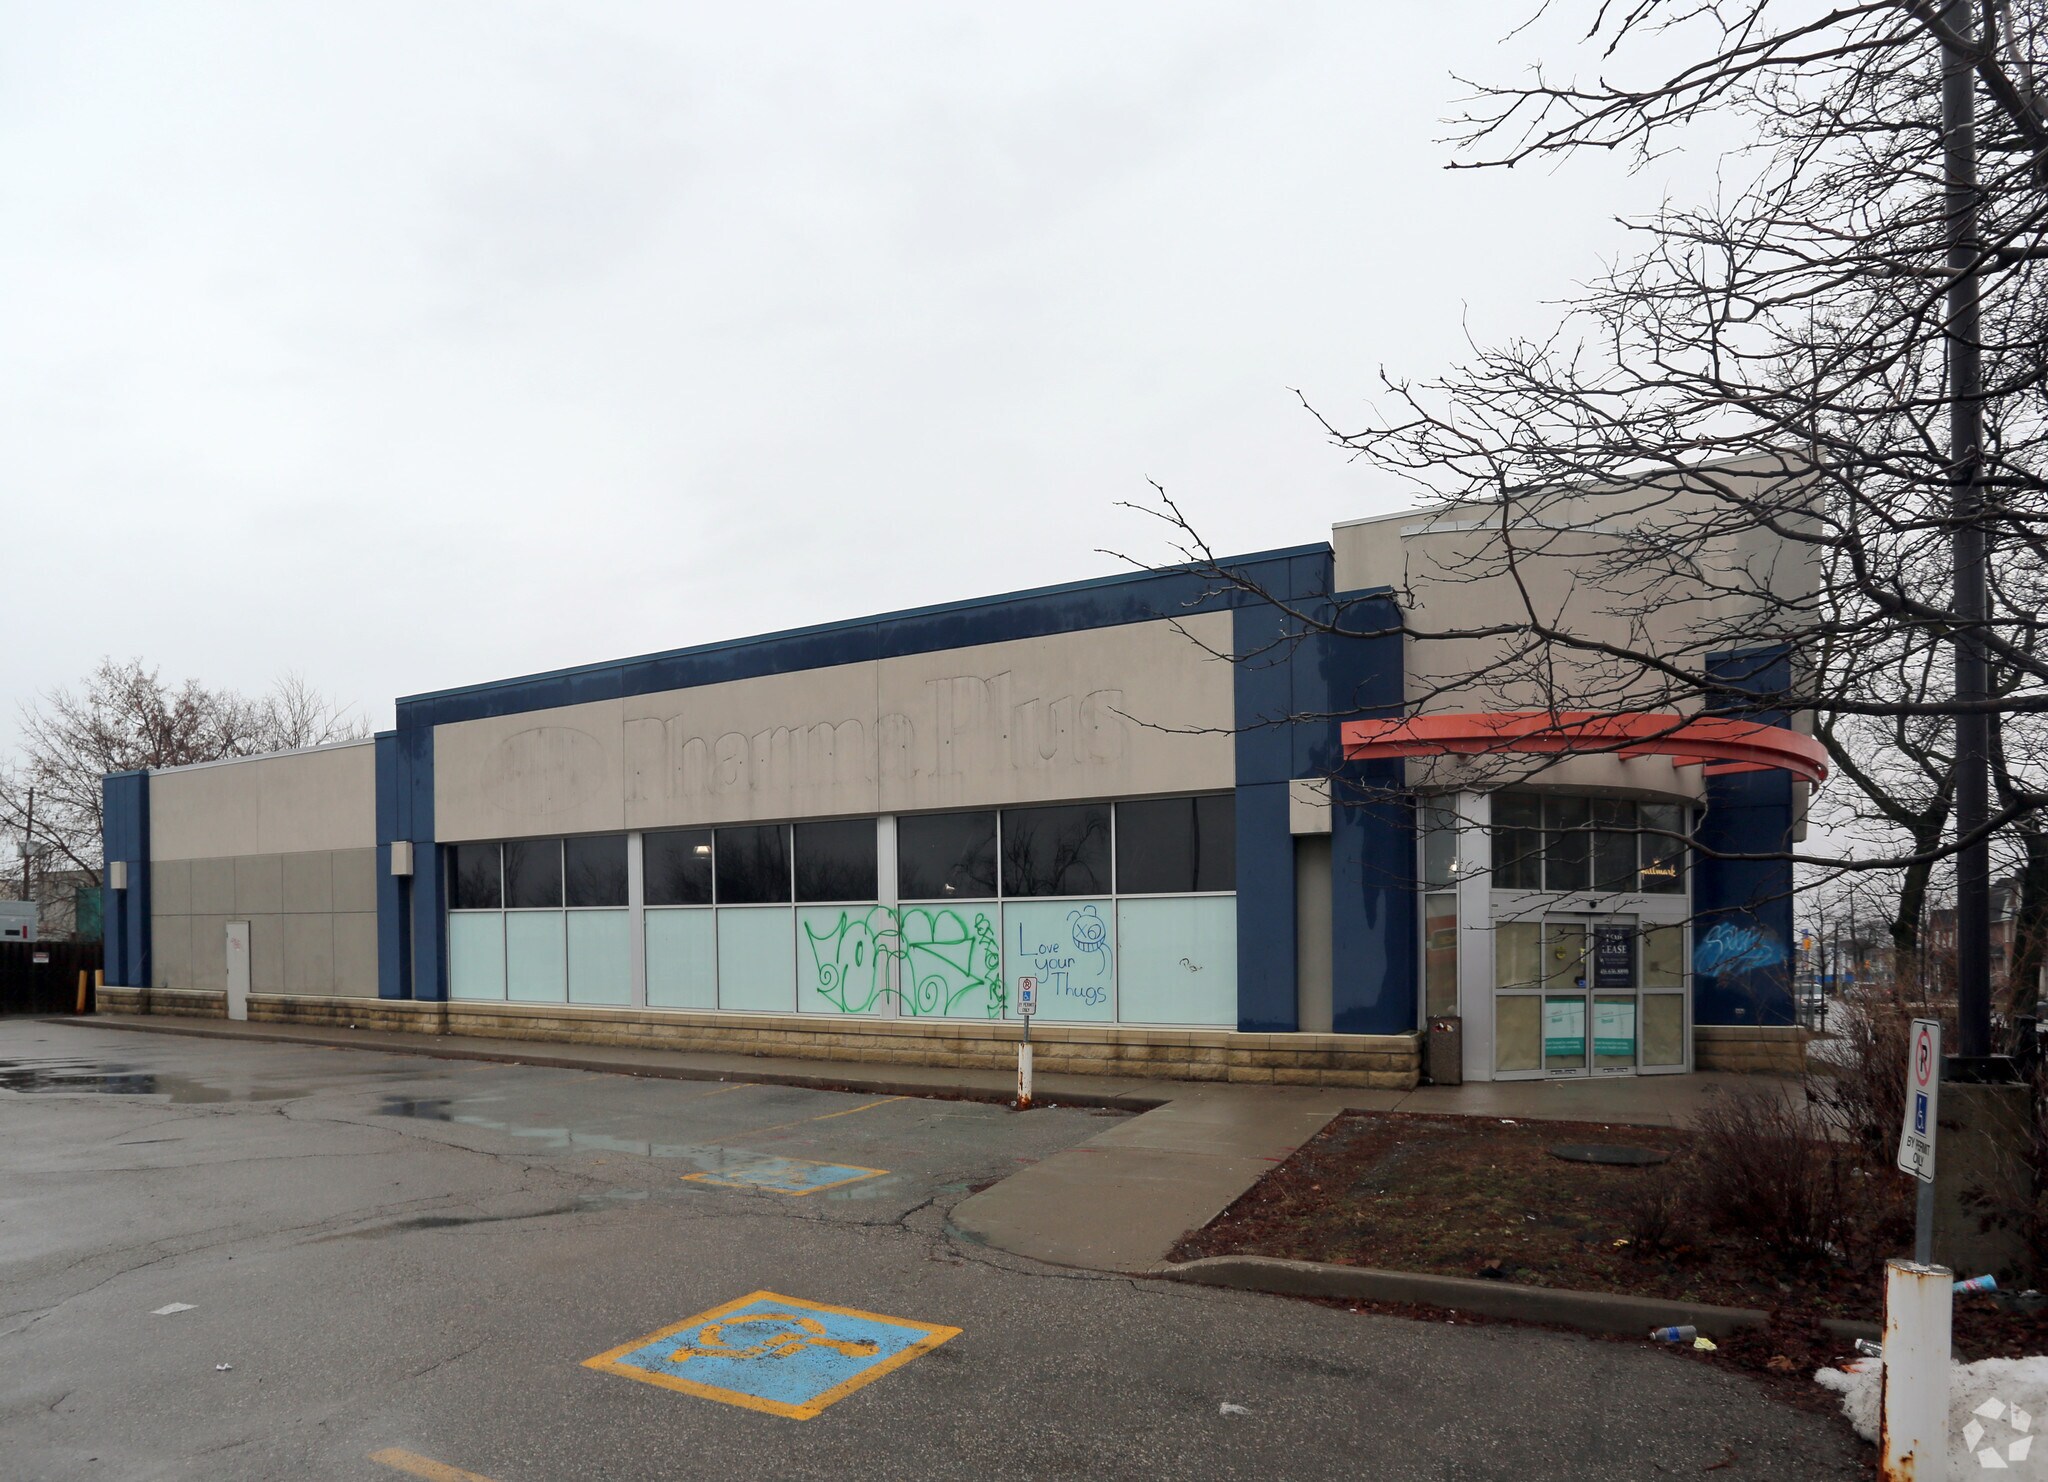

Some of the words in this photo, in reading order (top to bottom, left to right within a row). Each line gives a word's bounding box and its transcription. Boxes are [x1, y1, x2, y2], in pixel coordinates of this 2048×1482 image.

[1019, 922, 1060, 956] Love
[1601, 944, 1628, 954] LEASE
[1034, 957, 1076, 984] your
[1051, 971, 1107, 1007] Thugs
[1907, 1136, 1915, 1148] BY
[1913, 1152, 1924, 1167] ONLY
